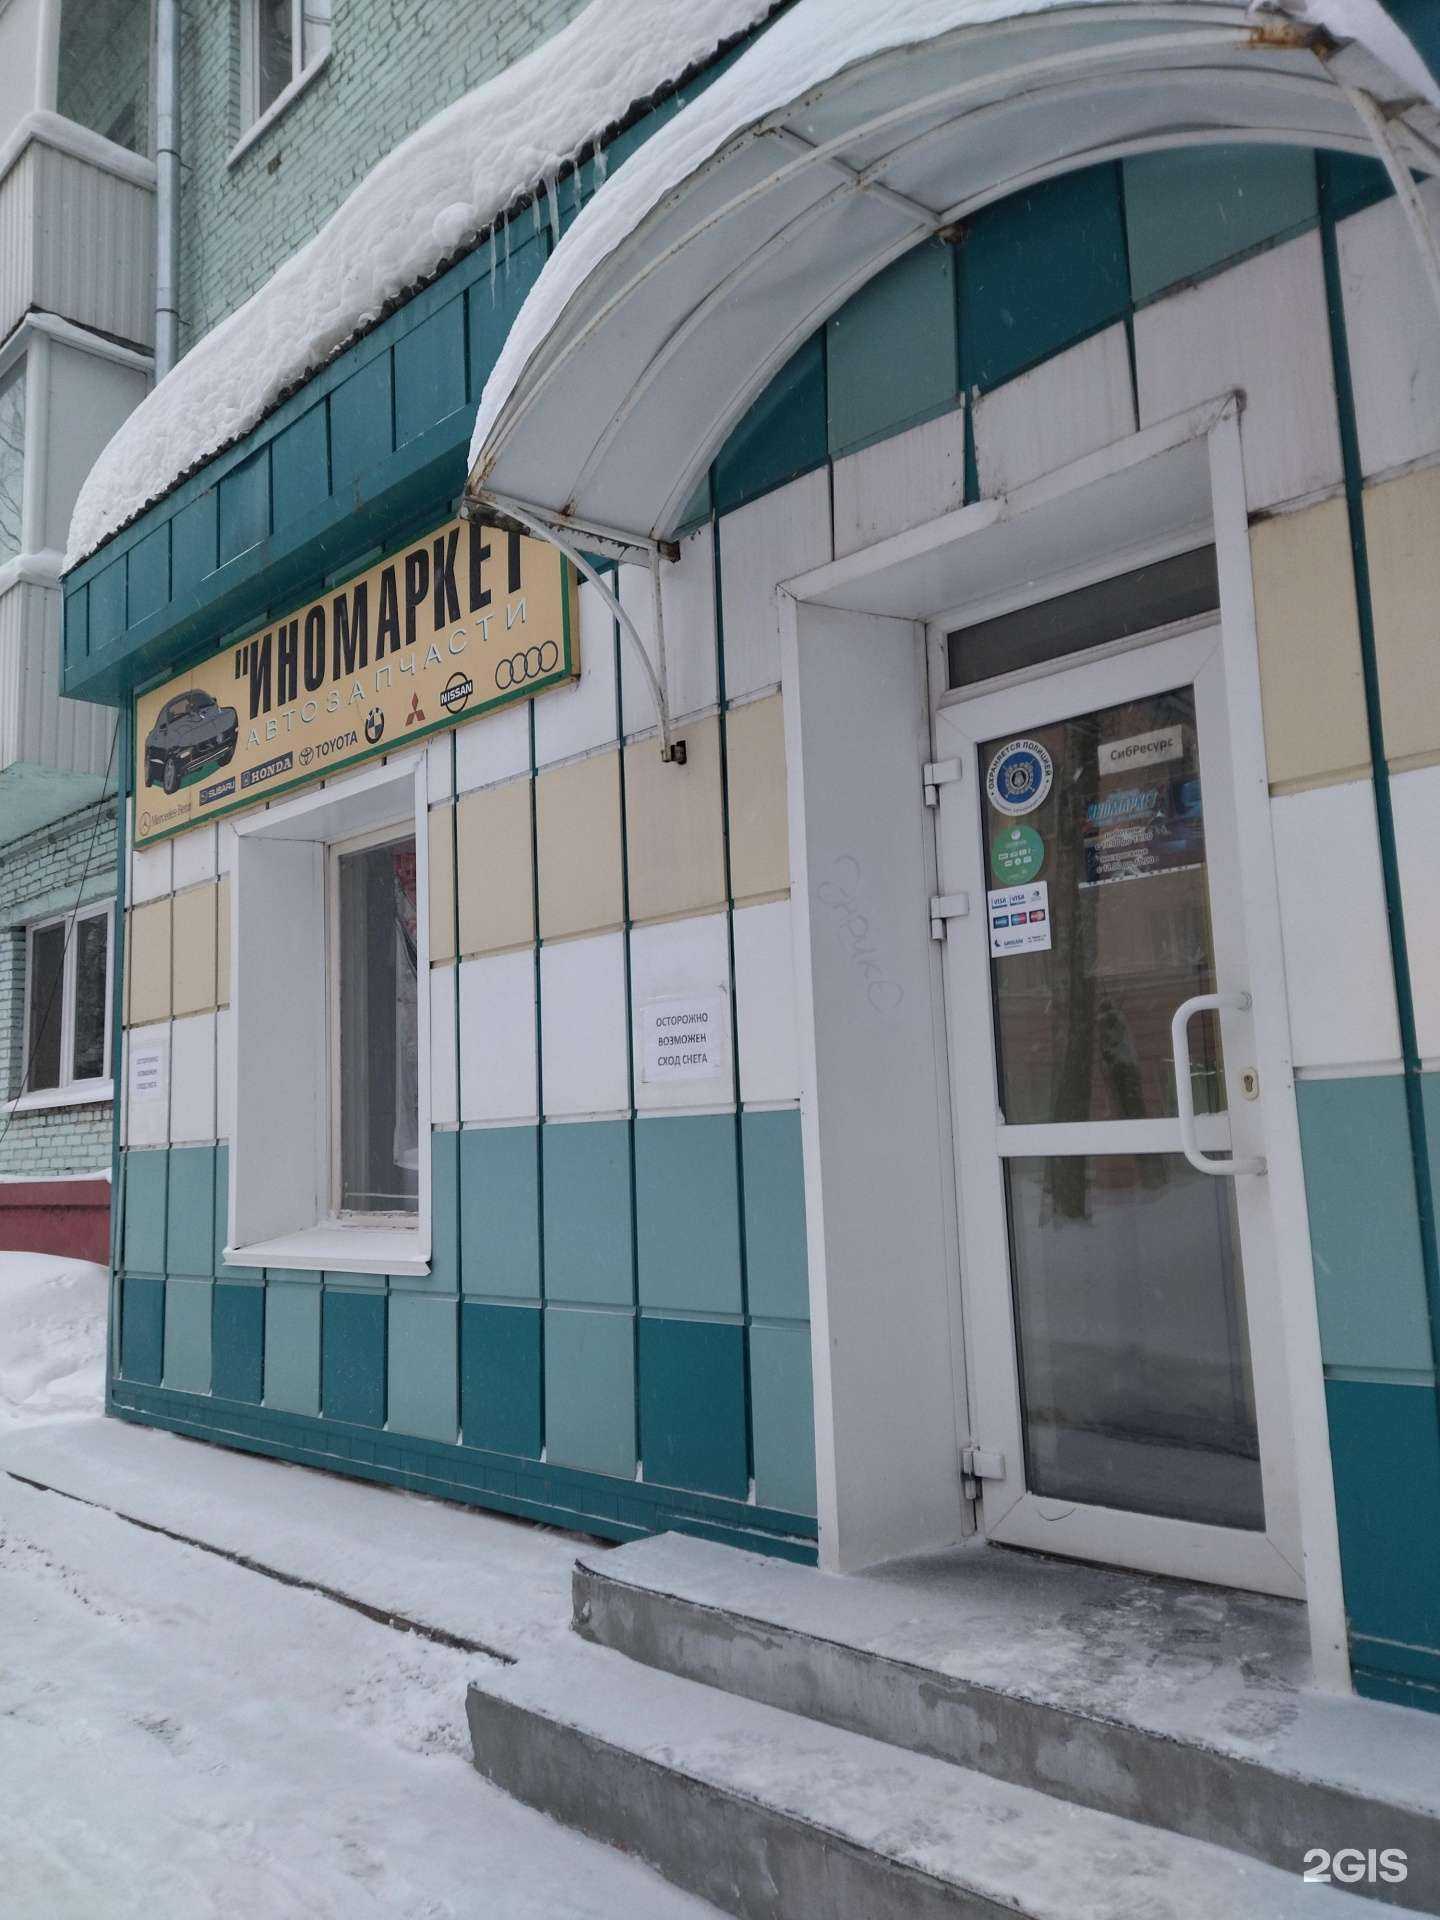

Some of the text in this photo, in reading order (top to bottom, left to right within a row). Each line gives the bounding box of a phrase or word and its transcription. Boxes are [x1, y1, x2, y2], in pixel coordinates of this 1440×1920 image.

[246, 597, 528, 750] АВТОЗАПЧАСТИ
[441, 682, 472, 704] NISSAN
[315, 730, 358, 759] TOYOTA
[1110, 738, 1174, 760] СибРесурс
[251, 757, 292, 783] HONDA
[988, 741, 1052, 790] ОХРАНЯЕТСЯ ПОЛИЦИЕЙ
[208, 781, 235, 798] SUBARU
[993, 896, 1007, 905] VISA
[1011, 894, 1025, 902] VISA
[656, 1012, 709, 1027] ОСТОРОЖНО
[658, 1033, 707, 1047] ВОЗМОЖЕН
[657, 1053, 708, 1067] СХОД СНЕГА
